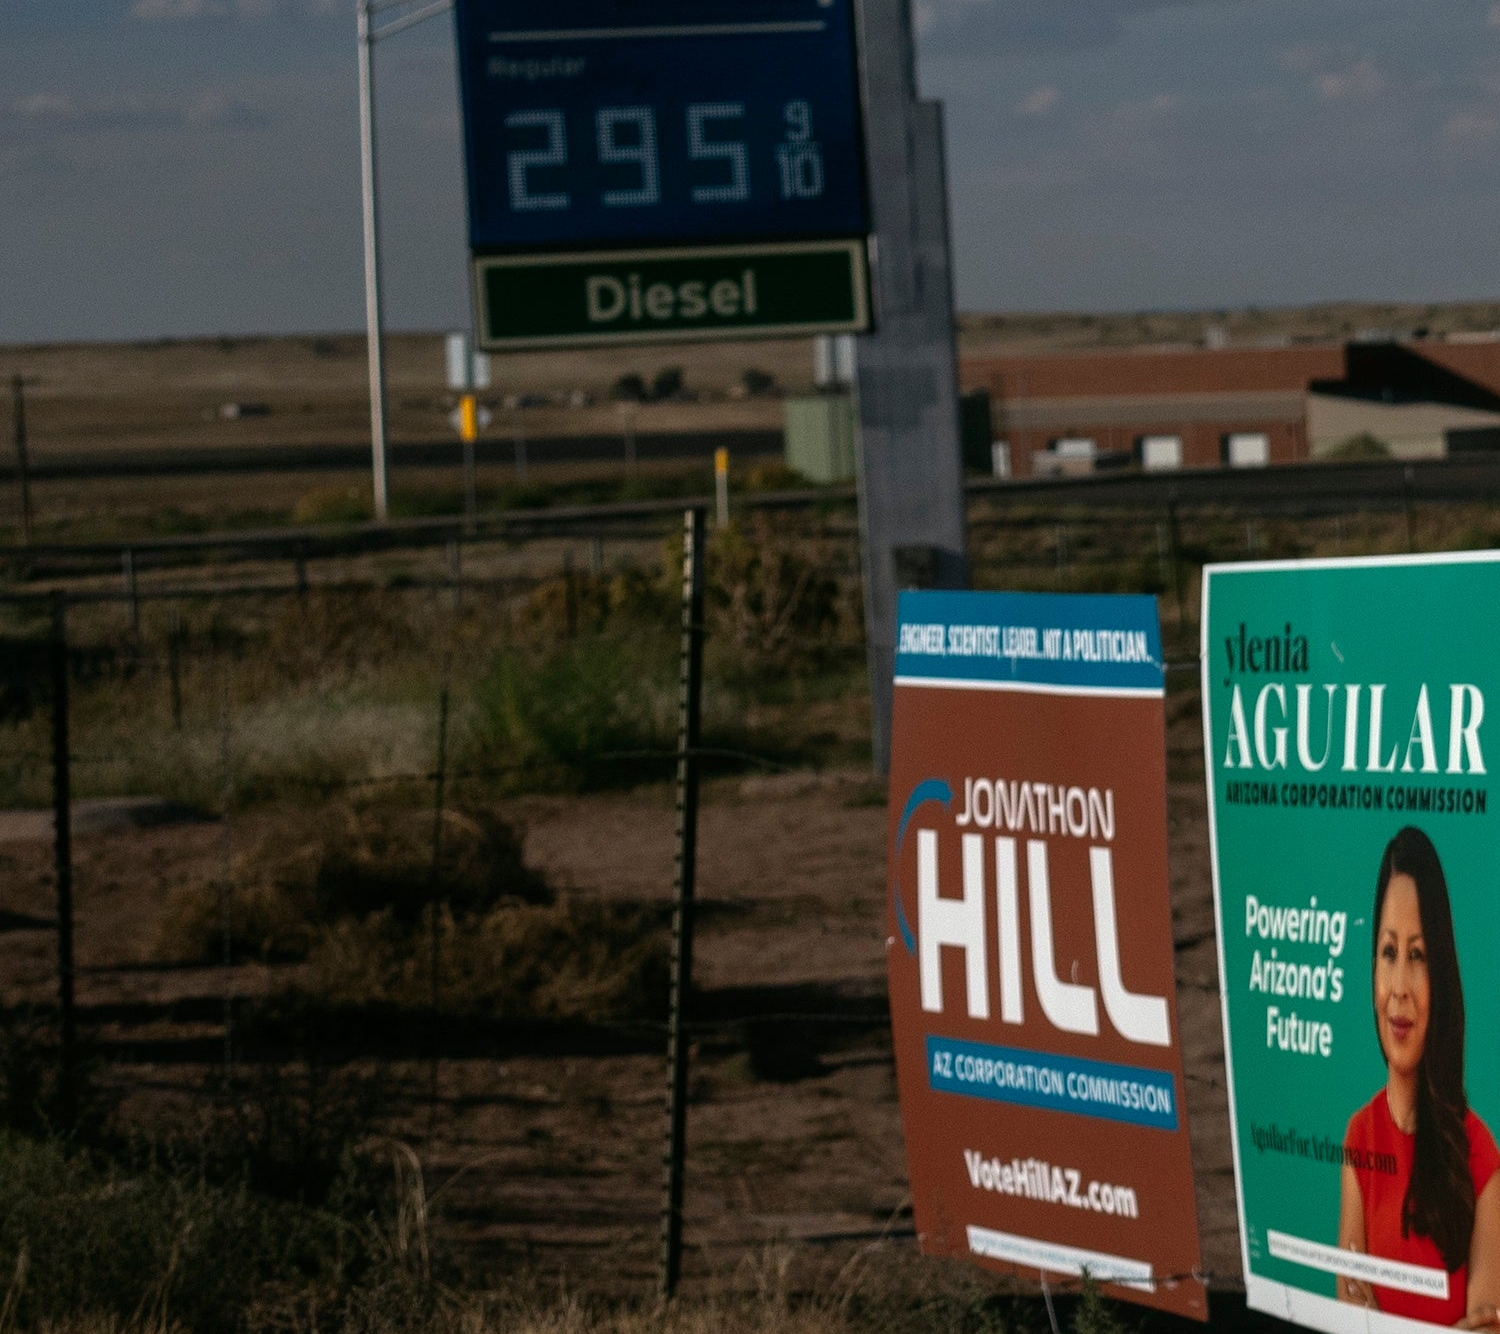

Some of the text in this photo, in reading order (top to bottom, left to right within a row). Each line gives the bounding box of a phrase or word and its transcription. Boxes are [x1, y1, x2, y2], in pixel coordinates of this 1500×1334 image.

[585, 268, 758, 323] Diesel
[900, 623, 946, 657] ENGINEER,
[948, 624, 1001, 658] SCIENTIST,
[1062, 630, 1073, 660] A
[1074, 629, 1151, 663] POLITICIAN.
[1224, 621, 1310, 688] ylenia
[1223, 682, 1487, 775] AGUILAR
[956, 777, 1115, 841] JONATHON
[1225, 779, 1487, 814] ARIZONA CORPORATION COMMISSION
[917, 828, 1172, 1048] HILL
[1245, 894, 1347, 958] Powering
[1249, 947, 1344, 1003] Arizona's
[1267, 1005, 1333, 1058] Future
[933, 1050, 1172, 1115] AZ CORPORATION COMMISSION
[963, 1148, 1139, 1220] VoteHillAZ.com
